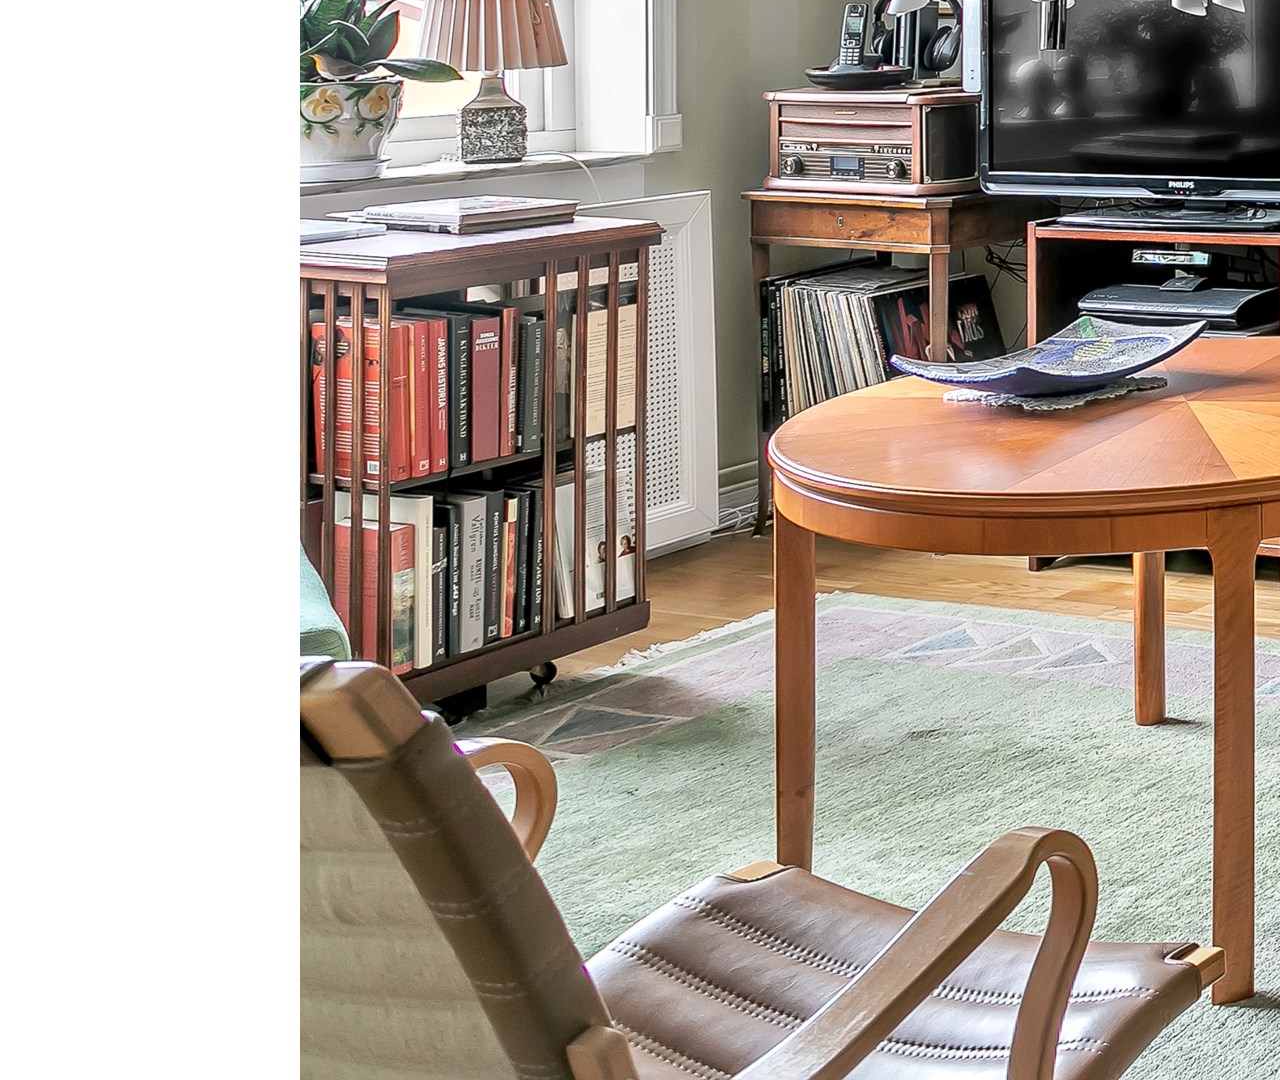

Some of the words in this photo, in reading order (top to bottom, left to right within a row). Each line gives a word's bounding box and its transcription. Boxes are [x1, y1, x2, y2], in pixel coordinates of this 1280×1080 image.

[1168, 181, 1195, 189] PHILIPS
[437, 337, 446, 368] JAPANS
[459, 339, 467, 385] KUNGLIGA
[437, 368, 447, 409] HISTORIA
[470, 515, 481, 553] Vallgren
[492, 511, 500, 537] PONTUS
